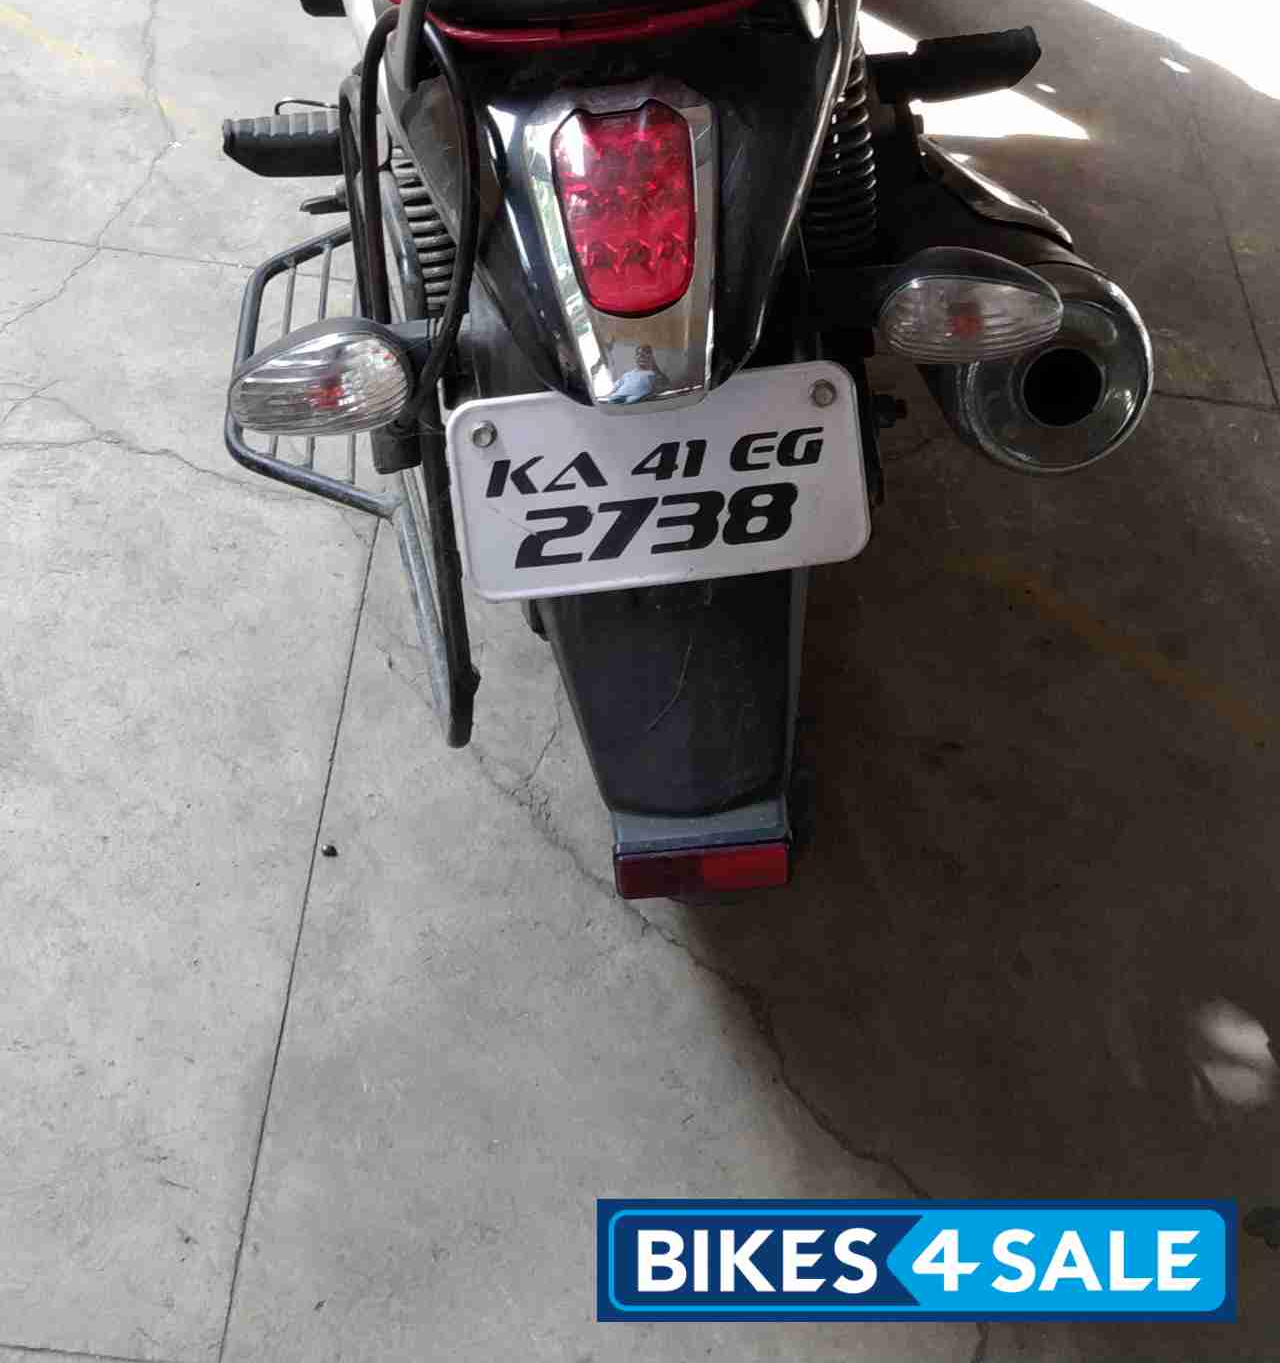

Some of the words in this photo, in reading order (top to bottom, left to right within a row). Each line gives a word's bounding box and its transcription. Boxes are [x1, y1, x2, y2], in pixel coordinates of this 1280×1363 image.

[485, 451, 609, 498] KA
[631, 439, 707, 481] 41
[730, 426, 824, 472] EG
[514, 482, 799, 569] 2738
